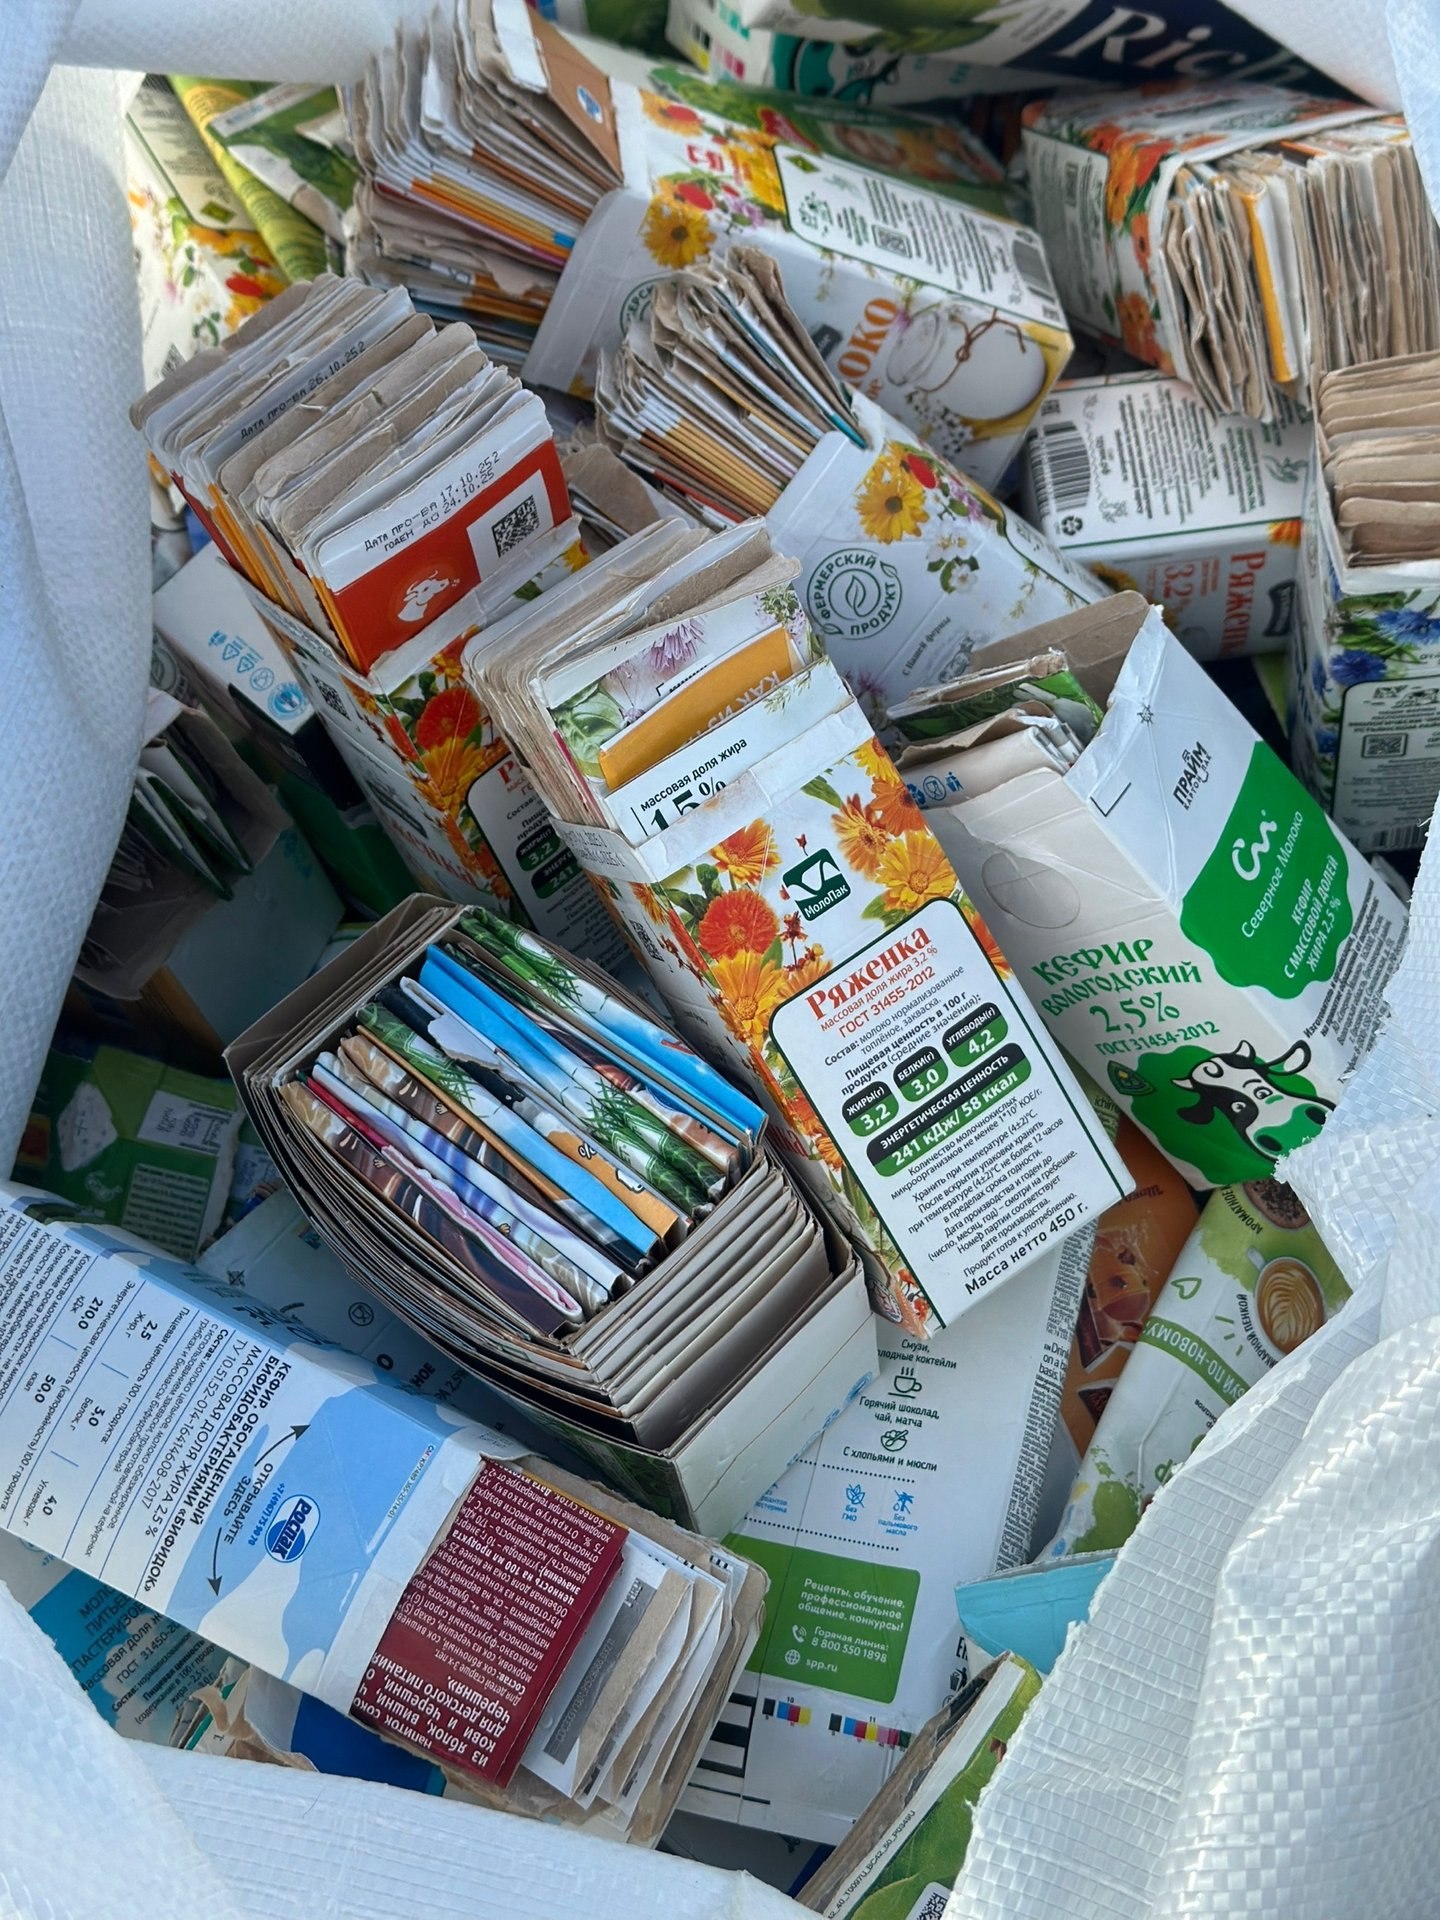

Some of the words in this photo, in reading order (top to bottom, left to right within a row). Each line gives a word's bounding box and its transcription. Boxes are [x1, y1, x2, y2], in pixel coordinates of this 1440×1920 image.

[442, 467, 494, 514] 24.10.25
[813, 553, 878, 620] ФЕРМЕРСКИЙ
[850, 582, 896, 636] ПРОДУКТ
[640, 774, 691, 811] массовая
[691, 756, 718, 780] доля
[717, 738, 747, 762] жира
[1173, 741, 1207, 806] ПРАЙМ
[528, 842, 553, 865] 3,2
[1241, 866, 1282, 937] Северное
[1276, 810, 1303, 867] Молоко
[803, 884, 848, 917] МолоПак
[1288, 896, 1322, 969] МАССОВОЙ
[1316, 854, 1338, 903] ДОЛЕЙ
[1291, 878, 1312, 925] КЕФИР
[1305, 930, 1327, 972] ЖИРА
[1320, 907, 1335, 933] 2,5
[1328, 895, 1341, 909] %
[807, 927, 930, 1018] Ряженка
[1031, 938, 1153, 986] КЕФИР
[820, 997, 865, 1031] массовая
[864, 980, 888, 1003] доля
[886, 963, 913, 985] жира
[911, 951, 928, 968] 3,2
[925, 944, 938, 955] %
[838, 1009, 869, 1038] ГОСТ
[870, 965, 935, 1015] 31455-2012
[1041, 961, 1202, 1016] ВОЛОГОДСКИЙ
[823, 1039, 859, 1066] Состав:
[858, 1017, 891, 1044] молоко
[890, 966, 963, 1021] нормализованное
[860, 1024, 903, 1055] топлёное,
[902, 997, 941, 1026] закваска.
[945, 1006, 995, 1046] УГЛЕВОДЫ(г)
[1089, 991, 1180, 1034] 2,5%
[841, 1060, 887, 1095] продукта
[886, 1030, 931, 1064] (средние
[931, 993, 981, 1033] значения):
[844, 1045, 891, 1080] Пищевая
[890, 1016, 936, 1049] ценность
[935, 1008, 943, 1018] в
[942, 994, 961, 1011] 100
[960, 991, 966, 1000] г
[968, 1028, 995, 1053] 4,2
[1094, 1042, 1132, 1056] ГОСТ
[1131, 1020, 1220, 1051] 31454-2012
[897, 1051, 935, 1081] БЕЛКИ(г)
[910, 1068, 939, 1095] 3,0
[846, 1086, 884, 1116] ЖИРЫ(г)
[859, 1102, 890, 1130] 3,2
[880, 1088, 961, 1148] ЭНЕРГЕТИЧЕСКАЯ
[959, 1055, 1008, 1093] ЦЕННОСТЬ
[891, 1138, 920, 1165] 241
[960, 1095, 981, 1117] 58
[981, 1071, 1018, 1102] ккал
[962, 1250, 996, 1277] Продукт
[995, 1235, 1018, 1254] готов
[1016, 1230, 1024, 1239] к
[1021, 1192, 1077, 1237] употреблению.
[964, 1260, 1009, 1295] Масса
[1009, 1231, 1047, 1263] нетто
[1049, 1207, 1075, 1232] 450
[1076, 1201, 1088, 1213] г.
[77, 1296, 103, 1330] 210,0
[139, 1319, 158, 1340] 2,5
[231, 1338, 248, 1356] ТУ
[900, 1338, 930, 1353] Смузи,
[914, 1354, 957, 1368] коктейли
[33, 1373, 56, 1403] 50,0
[209, 1345, 261, 1420] МАССОВАЯ
[252, 1361, 291, 1408] КЕФИР,
[87, 1405, 105, 1427] 3,0
[858, 1394, 896, 1410] Горячий
[897, 1403, 940, 1420] шоколад,
[874, 1412, 892, 1424] чай,
[894, 1415, 922, 1428] матча
[183, 1355, 278, 1506] БИФИДОБАКТЕРИЯМИ
[185, 1418, 215, 1460] ДОЛЯ
[190, 1412, 258, 1524] ОБОГАЩЕННЫЙ
[850, 1449, 895, 1464] хлопьями
[896, 1456, 904, 1466] и
[905, 1458, 937, 1471] мюсли
[161, 1459, 192, 1501] ЖИРА
[223, 1475, 251, 1516] ЗДЕСЬ
[41, 1494, 57, 1516] 4,0
[151, 1503, 168, 1525] 2,5
[223, 1462, 273, 1544] ОТКРЫВАЙТЕ
[257, 1514, 269, 1526] 75
[841, 1511, 857, 1522] ГМО
[144, 1524, 158, 1537] %
[247, 1534, 258, 1546] 70
[252, 1524, 263, 1536] 90
[451, 1529, 492, 1557] продукта
[144, 1508, 186, 1591] «БИФИДОК»
[491, 1552, 505, 1565] мл
[504, 1560, 520, 1575] 100
[521, 1569, 534, 1582] на
[534, 1574, 574, 1605] ценность
[800, 1591, 901, 1619] профессиональное
[813, 1625, 853, 1643] Горячая
[853, 1637, 889, 1651] линия:
[848, 1614, 904, 1631] конкурсы!
[805, 1658, 838, 1672] spp.ru
[810, 1636, 819, 1646] 8
[819, 1638, 841, 1651] 800
[841, 1643, 861, 1656] 550
[862, 1648, 887, 1663] 1898
[375, 1688, 420, 1725] вишни,
[379, 1674, 440, 1720] черешни,
[423, 1683, 481, 1722] детского
[426, 1718, 467, 1753] яблок,
[446, 1716, 458, 1730] и
[462, 1725, 496, 1752] кови
[478, 1715, 506, 1738] для
[471, 1749, 488, 1767] из
